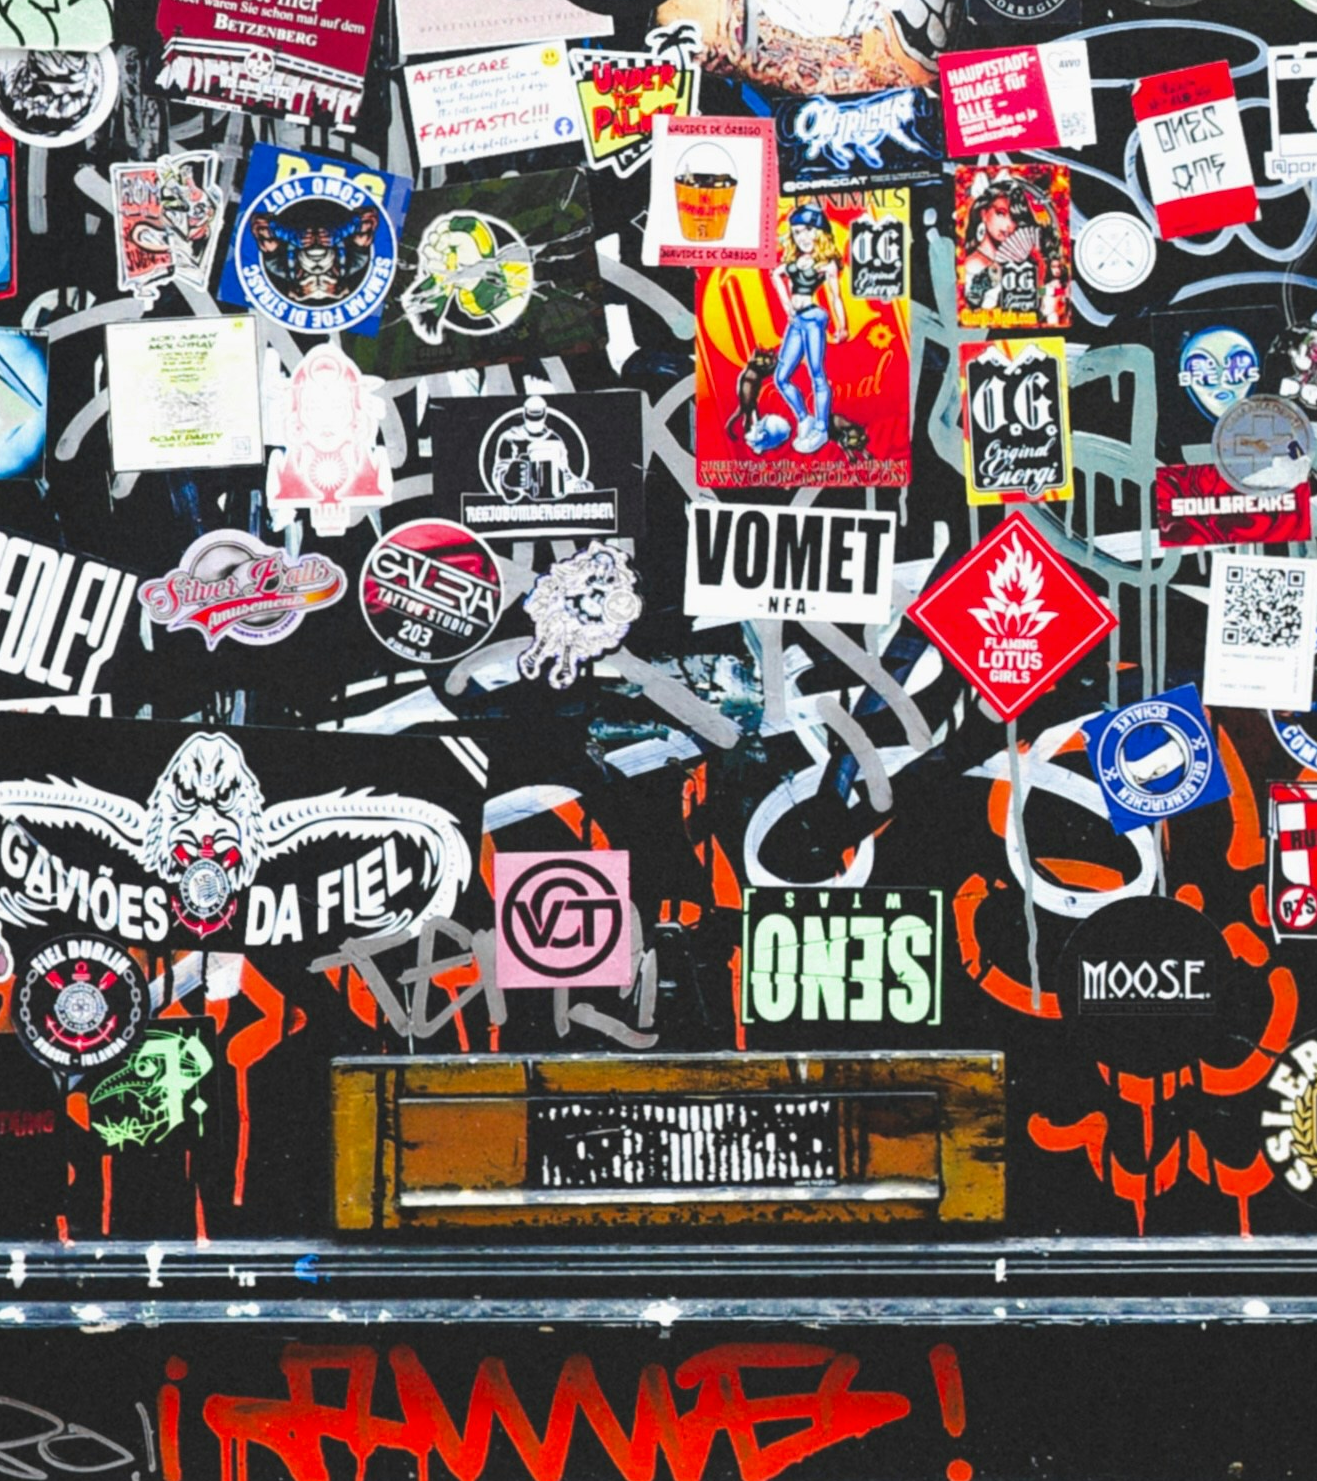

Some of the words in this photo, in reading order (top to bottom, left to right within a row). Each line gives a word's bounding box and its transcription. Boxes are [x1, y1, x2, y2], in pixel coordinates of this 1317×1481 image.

[951, 79, 1003, 103] ZULAGE
[1005, 71, 1028, 91] für
[1171, 493, 1297, 517] SOULBREAKS
[694, 509, 893, 596] VOMET
[397, 619, 433, 645] 203
[984, 636, 1039, 652] FLAMING
[978, 650, 1043, 672] LOTUS
[989, 669, 1031, 684] GIRLS
[0, 829, 167, 942] GAVIÕES
[246, 886, 302, 946] DA
[315, 839, 416, 935] FIEL
